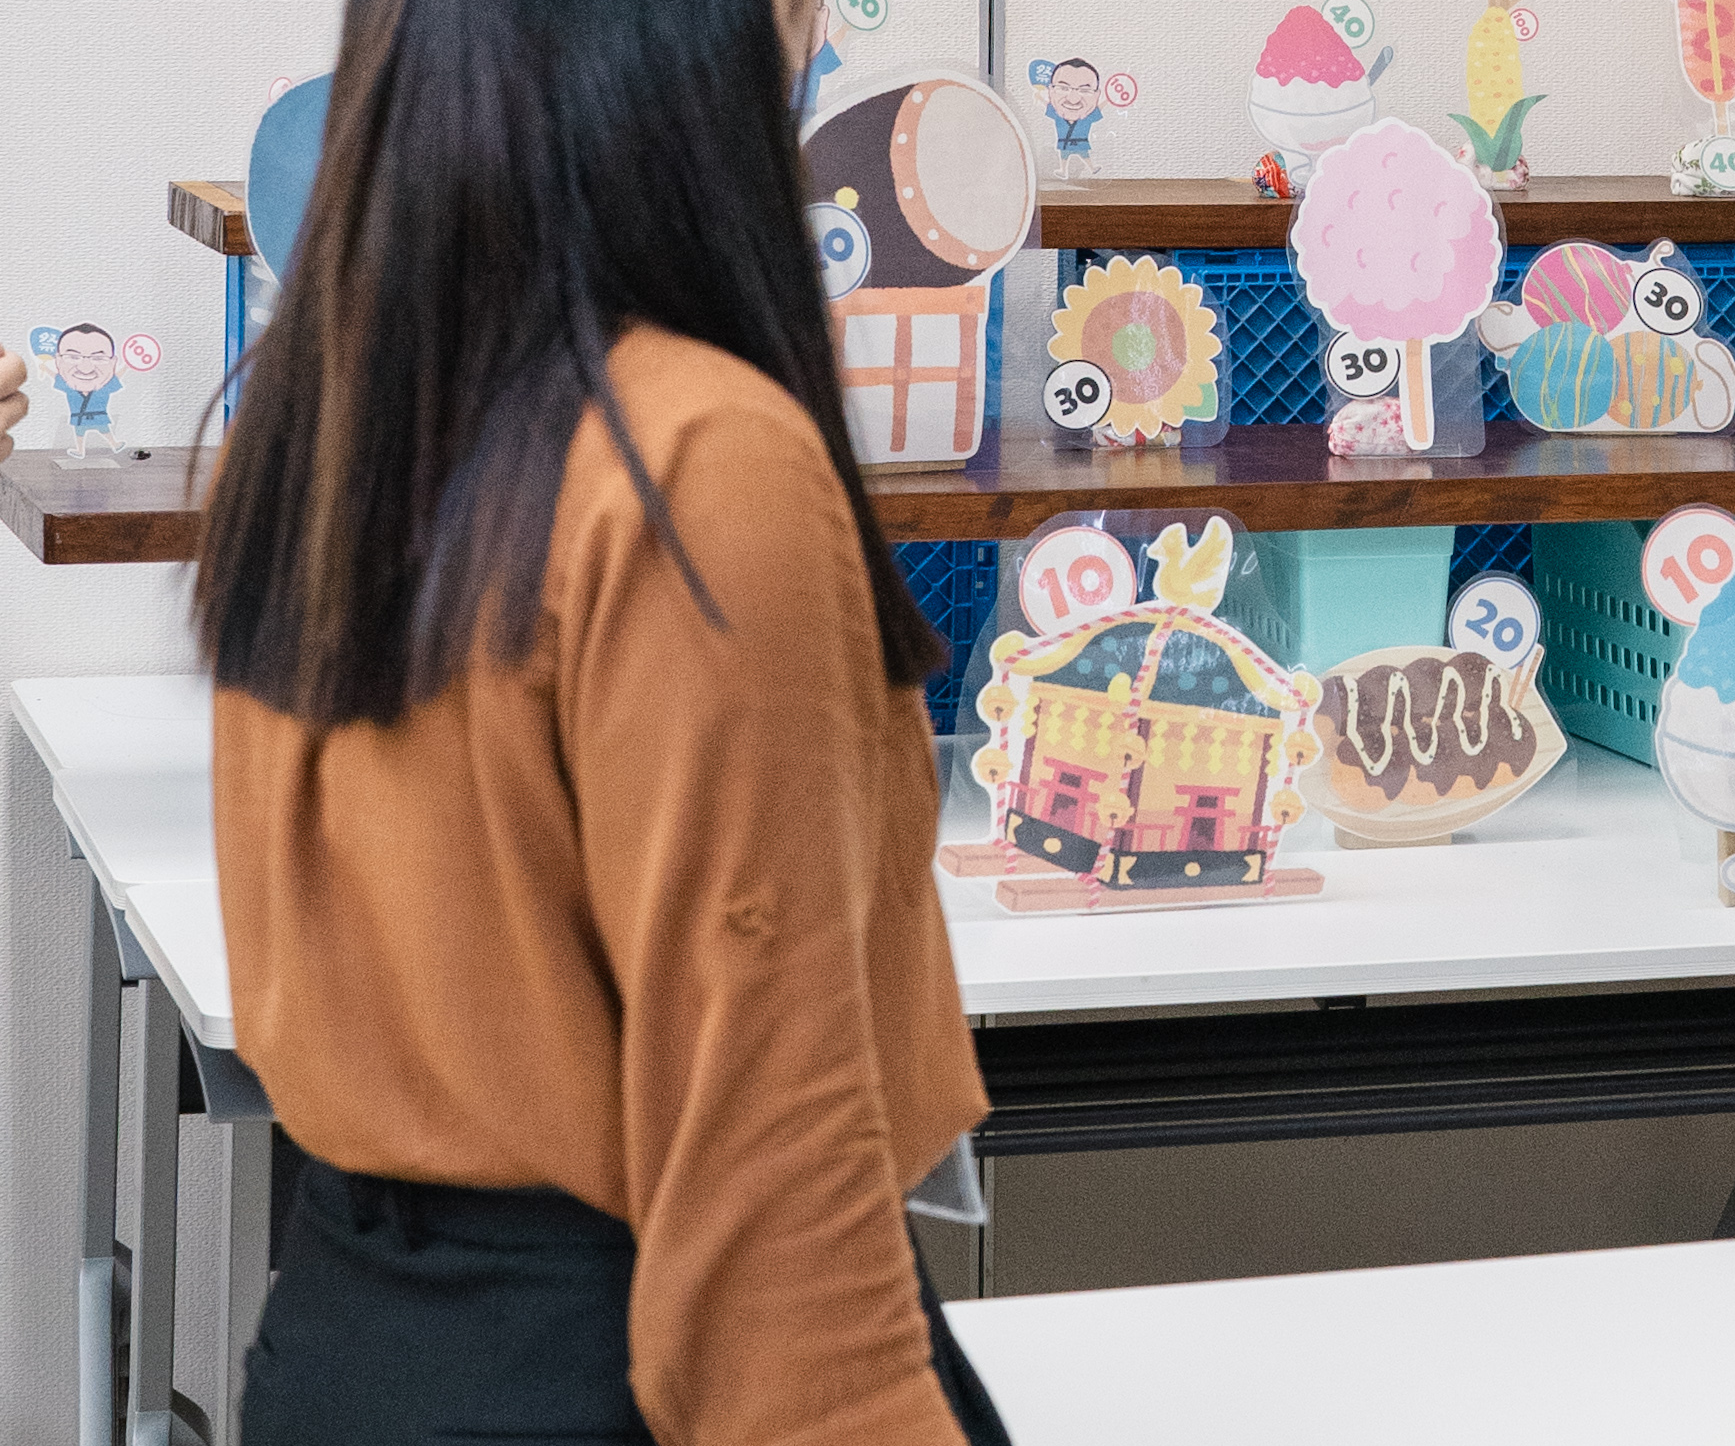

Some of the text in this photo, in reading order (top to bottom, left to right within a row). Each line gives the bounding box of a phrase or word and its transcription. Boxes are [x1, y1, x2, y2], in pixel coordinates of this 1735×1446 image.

[1329, 5, 1365, 38] 40
[1513, 12, 1530, 36] 100
[1110, 78, 1130, 102] 100
[821, 227, 855, 271] 0
[1643, 281, 1689, 321] 30
[128, 339, 153, 365] 100
[1340, 347, 1388, 381] 30
[1054, 376, 1100, 416] 30
[1037, 554, 1114, 619] 10
[1660, 533, 1734, 604] 10
[1464, 598, 1524, 652] 20
